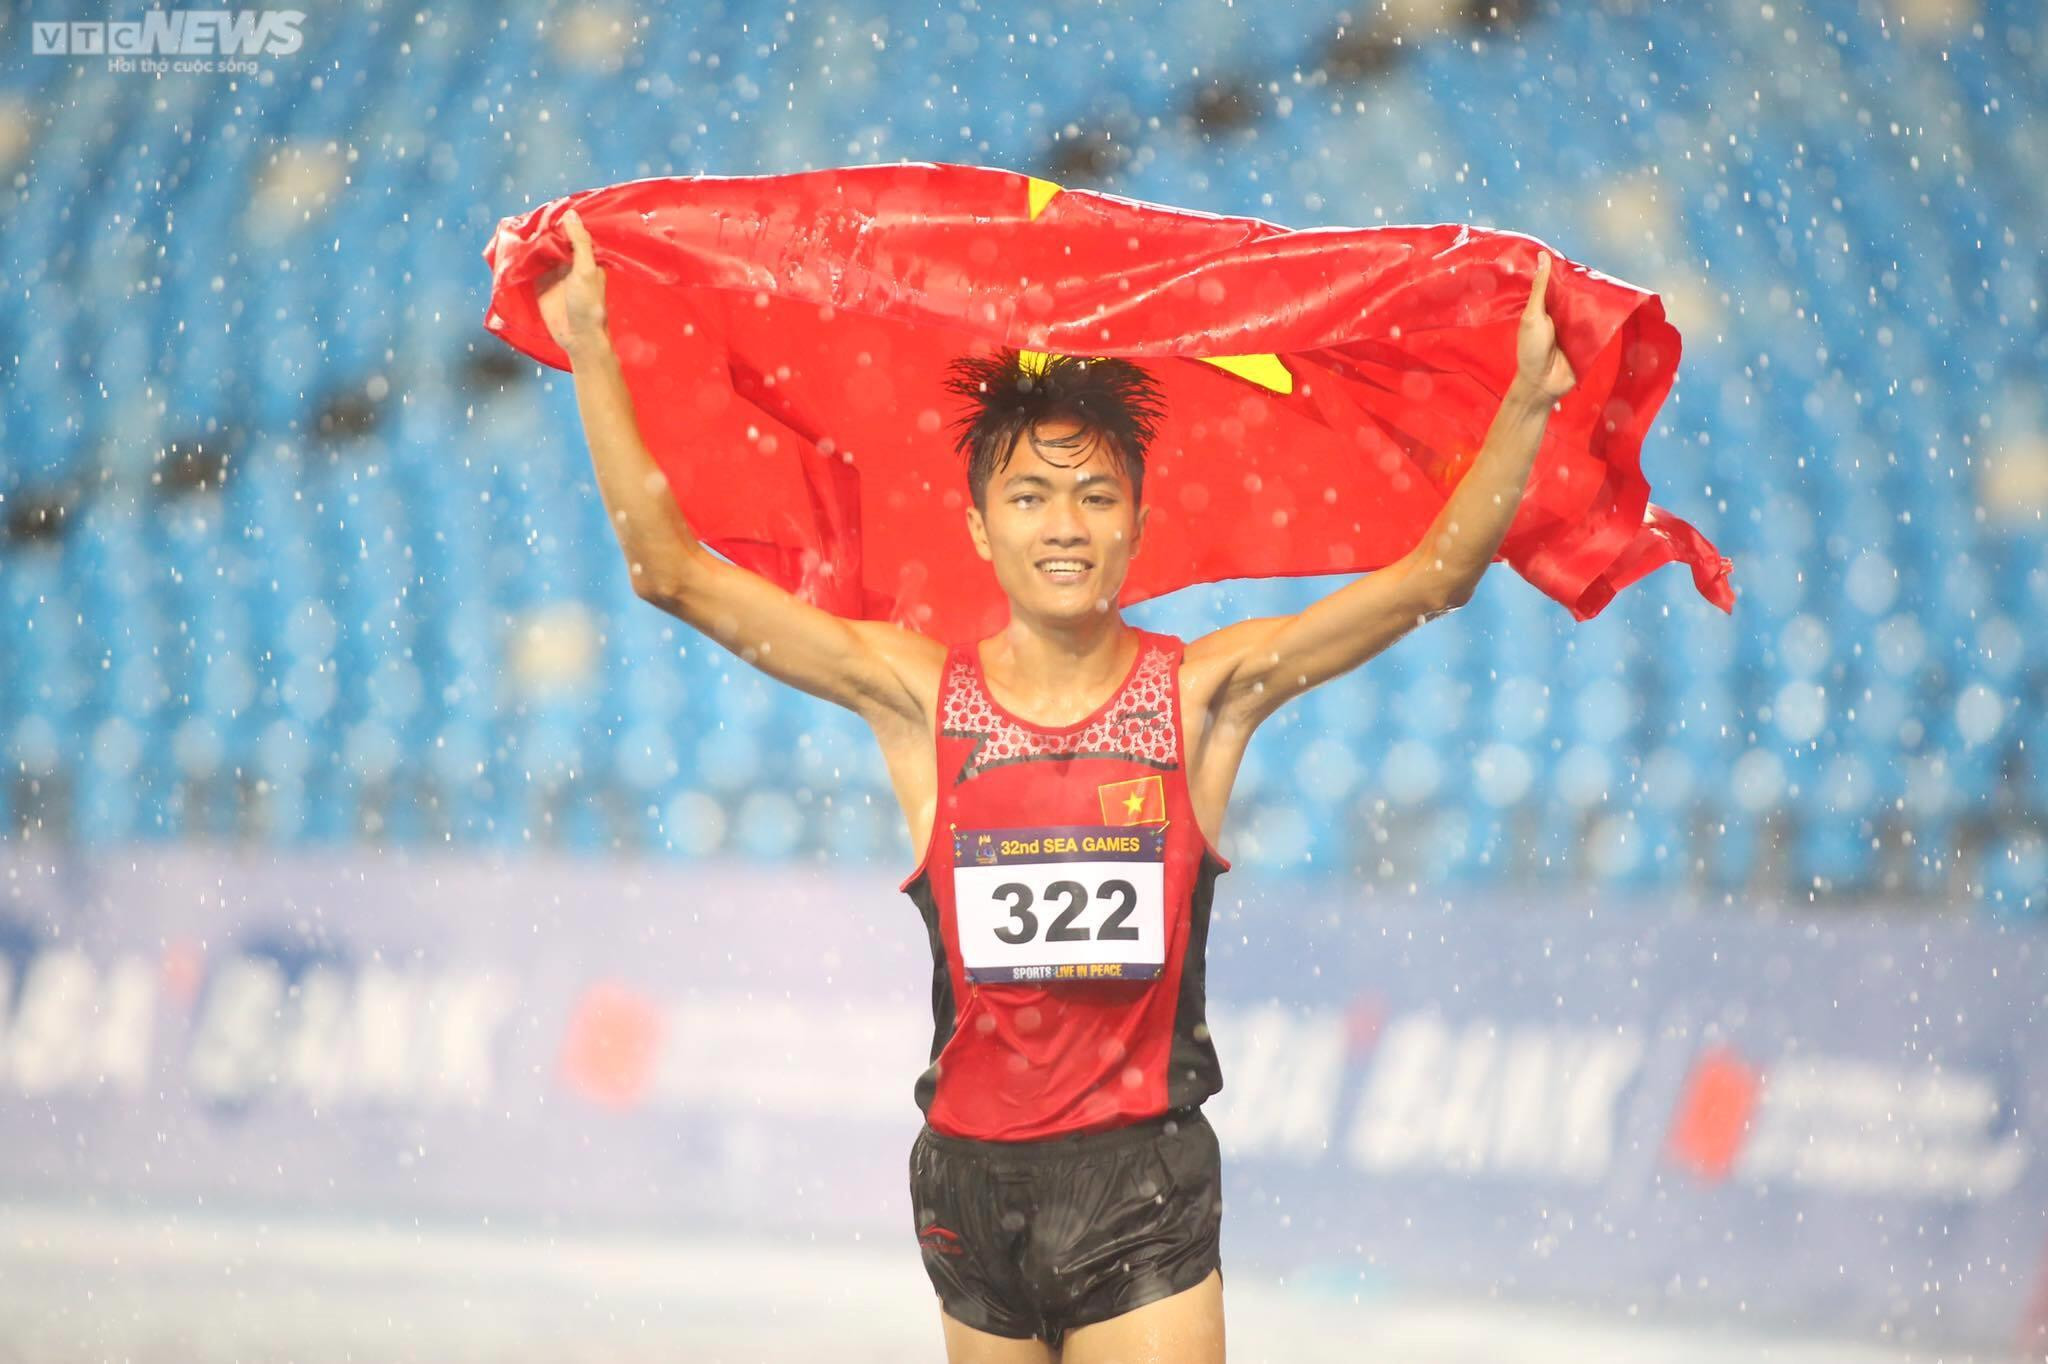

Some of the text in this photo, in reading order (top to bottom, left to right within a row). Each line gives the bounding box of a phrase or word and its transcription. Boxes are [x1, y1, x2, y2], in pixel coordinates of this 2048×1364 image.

[1001, 836, 1141, 856] 32nd SEA GAMES
[991, 879, 1140, 945] 322
[1056, 965, 1075, 978] LIVE
[1077, 965, 1088, 978] IN
[1090, 964, 1123, 977] PEACE
